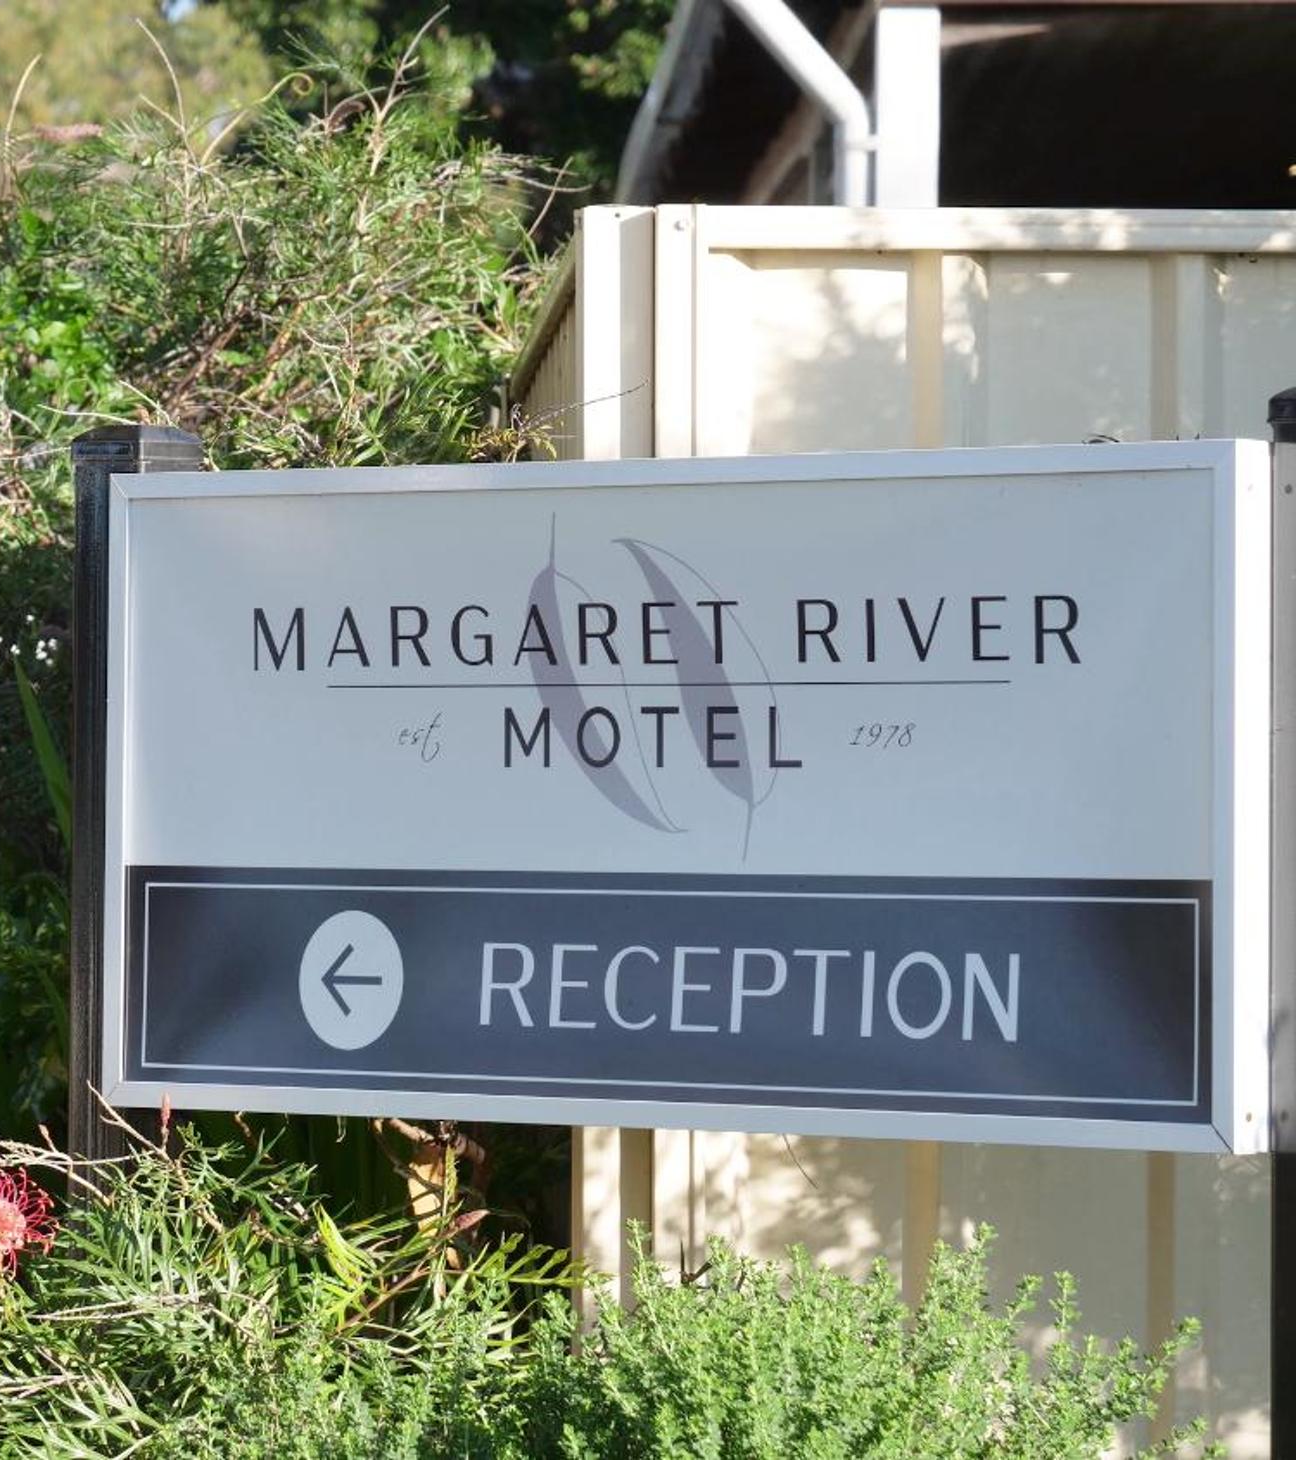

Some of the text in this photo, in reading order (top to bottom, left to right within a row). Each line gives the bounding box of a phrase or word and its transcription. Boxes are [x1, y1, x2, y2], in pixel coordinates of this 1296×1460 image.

[253, 595, 1082, 671] MARGARET RIVER
[398, 705, 917, 768] est MOTEL 1978
[477, 941, 1021, 1043] RECEPTION
